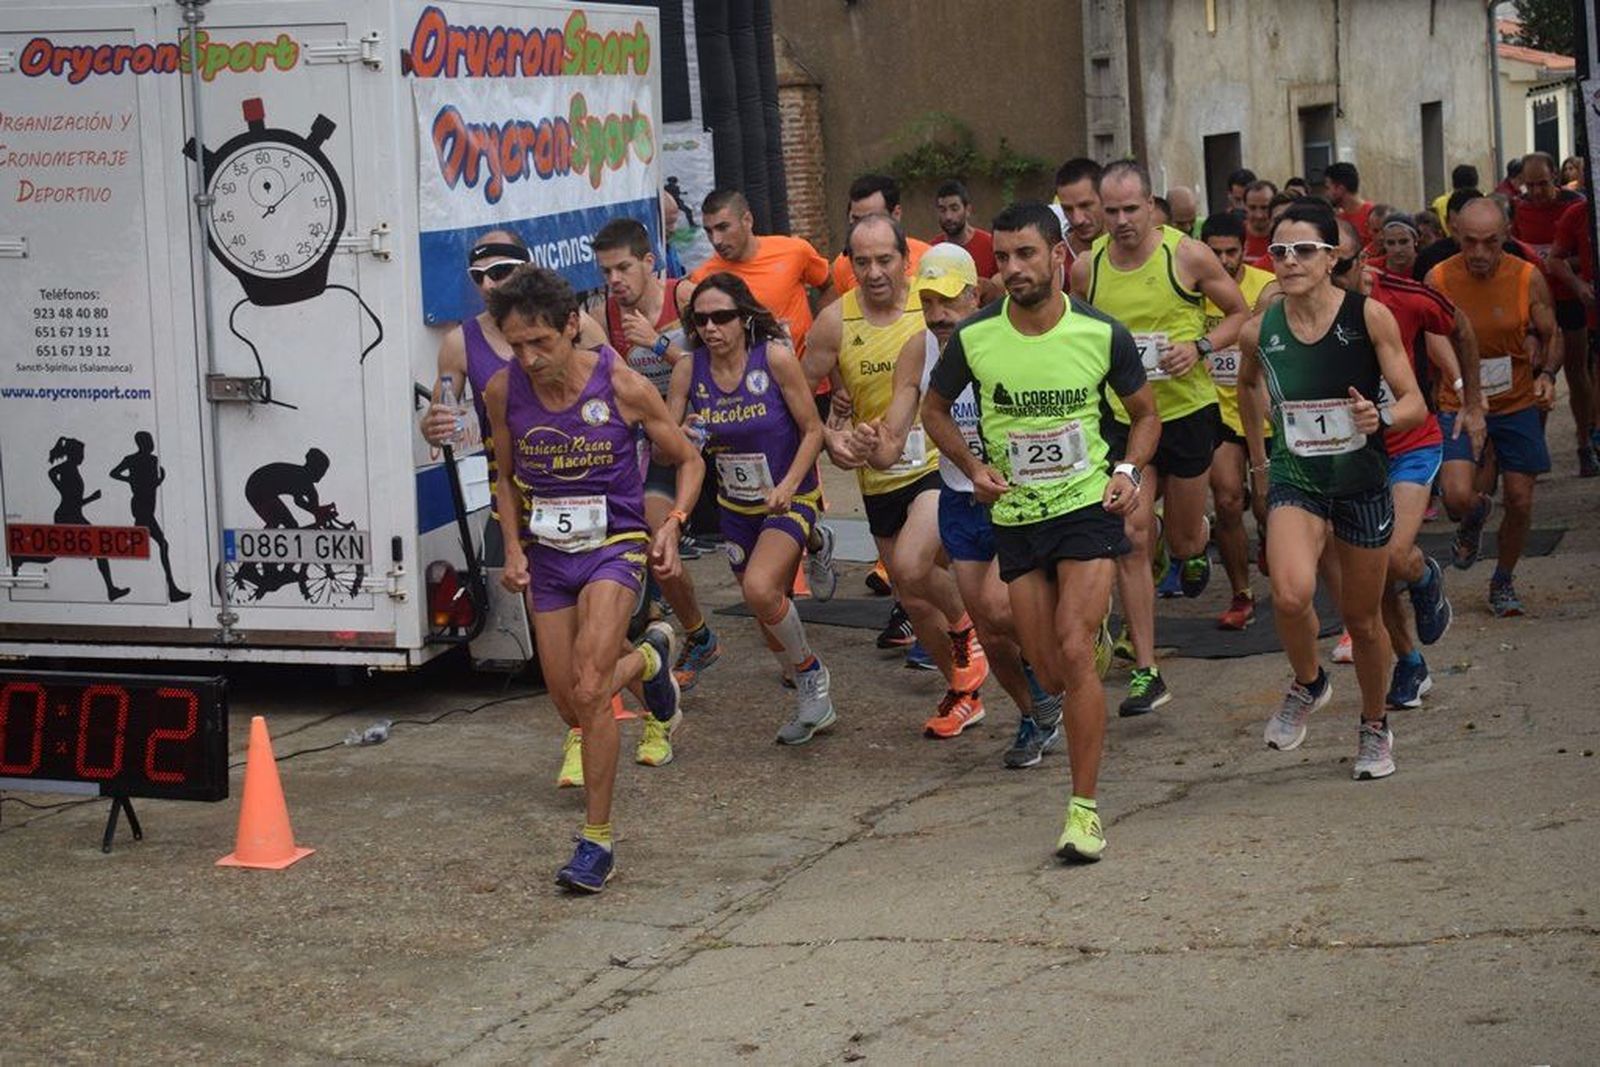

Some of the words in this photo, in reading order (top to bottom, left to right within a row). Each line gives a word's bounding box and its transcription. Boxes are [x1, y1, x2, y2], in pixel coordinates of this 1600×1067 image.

[20, 31, 299, 84] OrycronSport
[255, 152, 271, 164] 60
[283, 156, 291, 168] 5
[233, 163, 249, 176] 55
[301, 171, 314, 182] 10
[222, 182, 236, 195] 50
[313, 196, 327, 208] 15
[220, 211, 235, 223] 45
[231, 234, 246, 246] 40
[297, 242, 312, 254] 25
[250, 250, 266, 262] 35
[275, 254, 290, 266] 30
[40, 289, 100, 300] Teléfonos:
[33, 308, 55, 319] 923
[59, 308, 73, 319] 48
[76, 308, 91, 319] 40
[94, 308, 108, 319] 80
[35, 326, 56, 338] 651
[60, 327, 74, 338] 67
[78, 327, 92, 338] 19
[96, 327, 109, 338] 11
[36, 345, 57, 357] 651
[61, 345, 75, 357] 67
[80, 345, 93, 357] 19
[97, 345, 111, 357] 12
[80, 363, 133, 374] (Salamanca)
[1214, 357, 1236, 371] 28
[1, 387, 151, 401] www.orycronsport.com
[1314, 414, 1327, 435] 1
[1027, 444, 1063, 464] 23
[553, 453, 614, 469] Macotera
[735, 466, 748, 482] 6
[557, 513, 572, 533] 5
[10, 528, 24, 552] R
[31, 528, 93, 553] 0686
[99, 531, 144, 555] BCP
[240, 533, 302, 558] 0861
[315, 535, 364, 559] GKN
